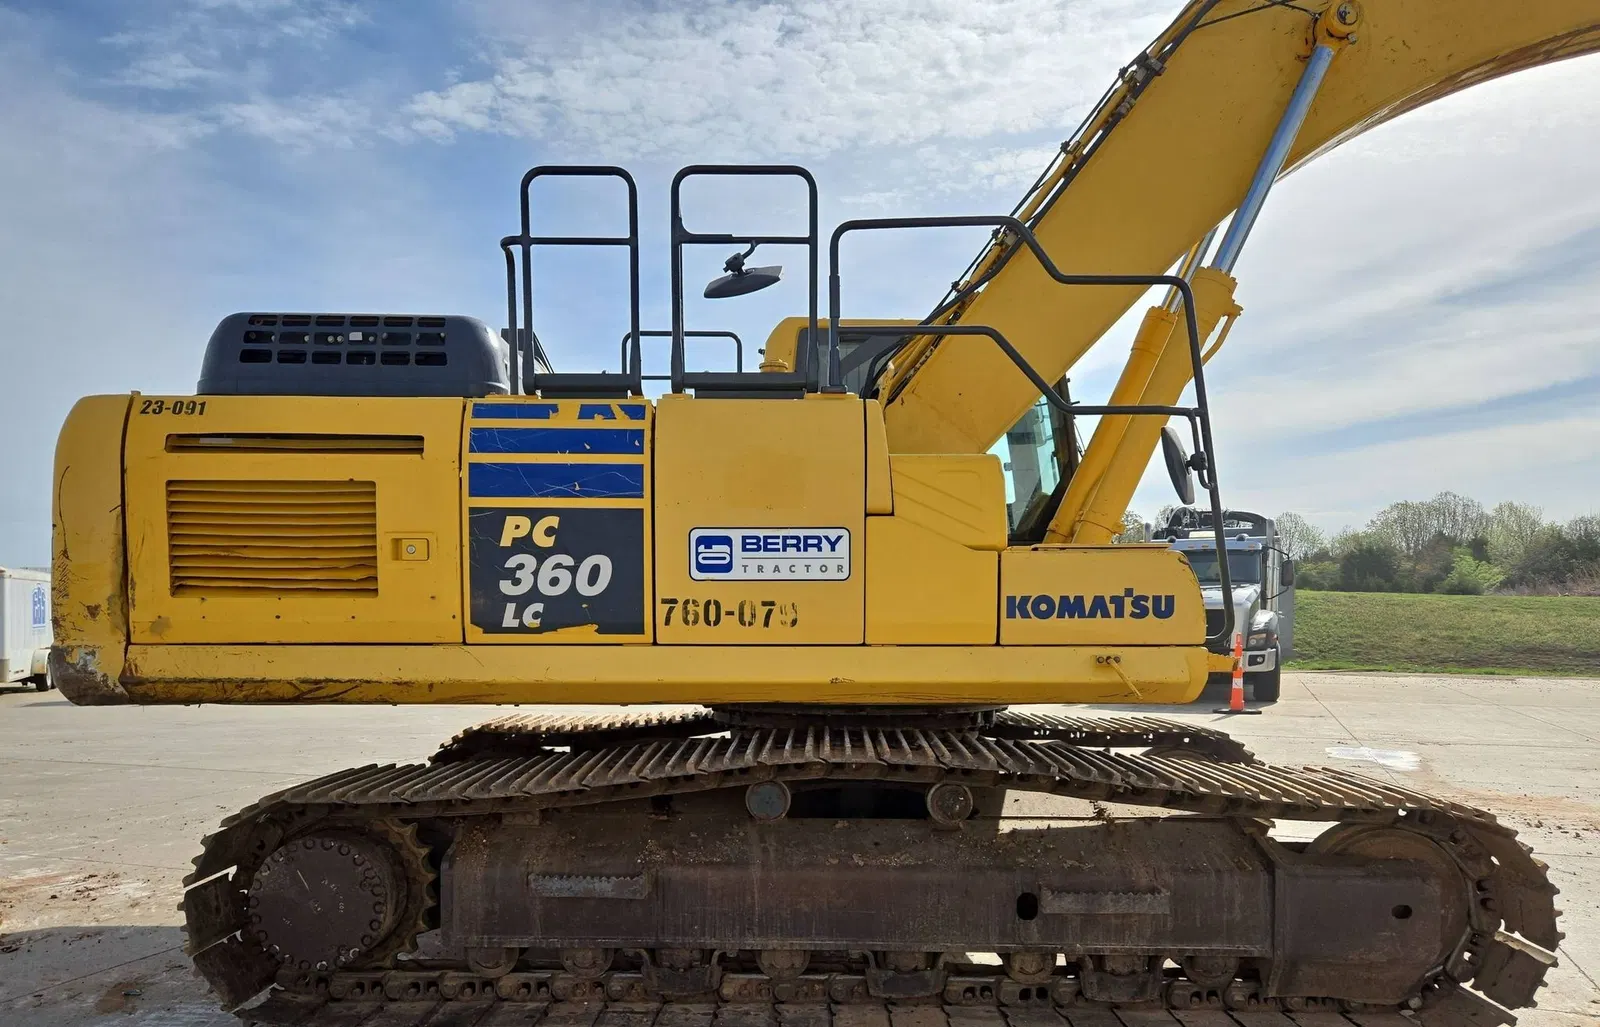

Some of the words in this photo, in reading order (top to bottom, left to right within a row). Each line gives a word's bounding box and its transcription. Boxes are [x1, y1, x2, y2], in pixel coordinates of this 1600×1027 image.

[140, 400, 206, 415] 23-091
[499, 515, 560, 548] PC
[741, 535, 844, 552] BERRY
[499, 553, 613, 597] 360
[742, 564, 844, 573] TRACTOR
[501, 602, 544, 628] LC
[1006, 587, 1175, 619] KOMATSU
